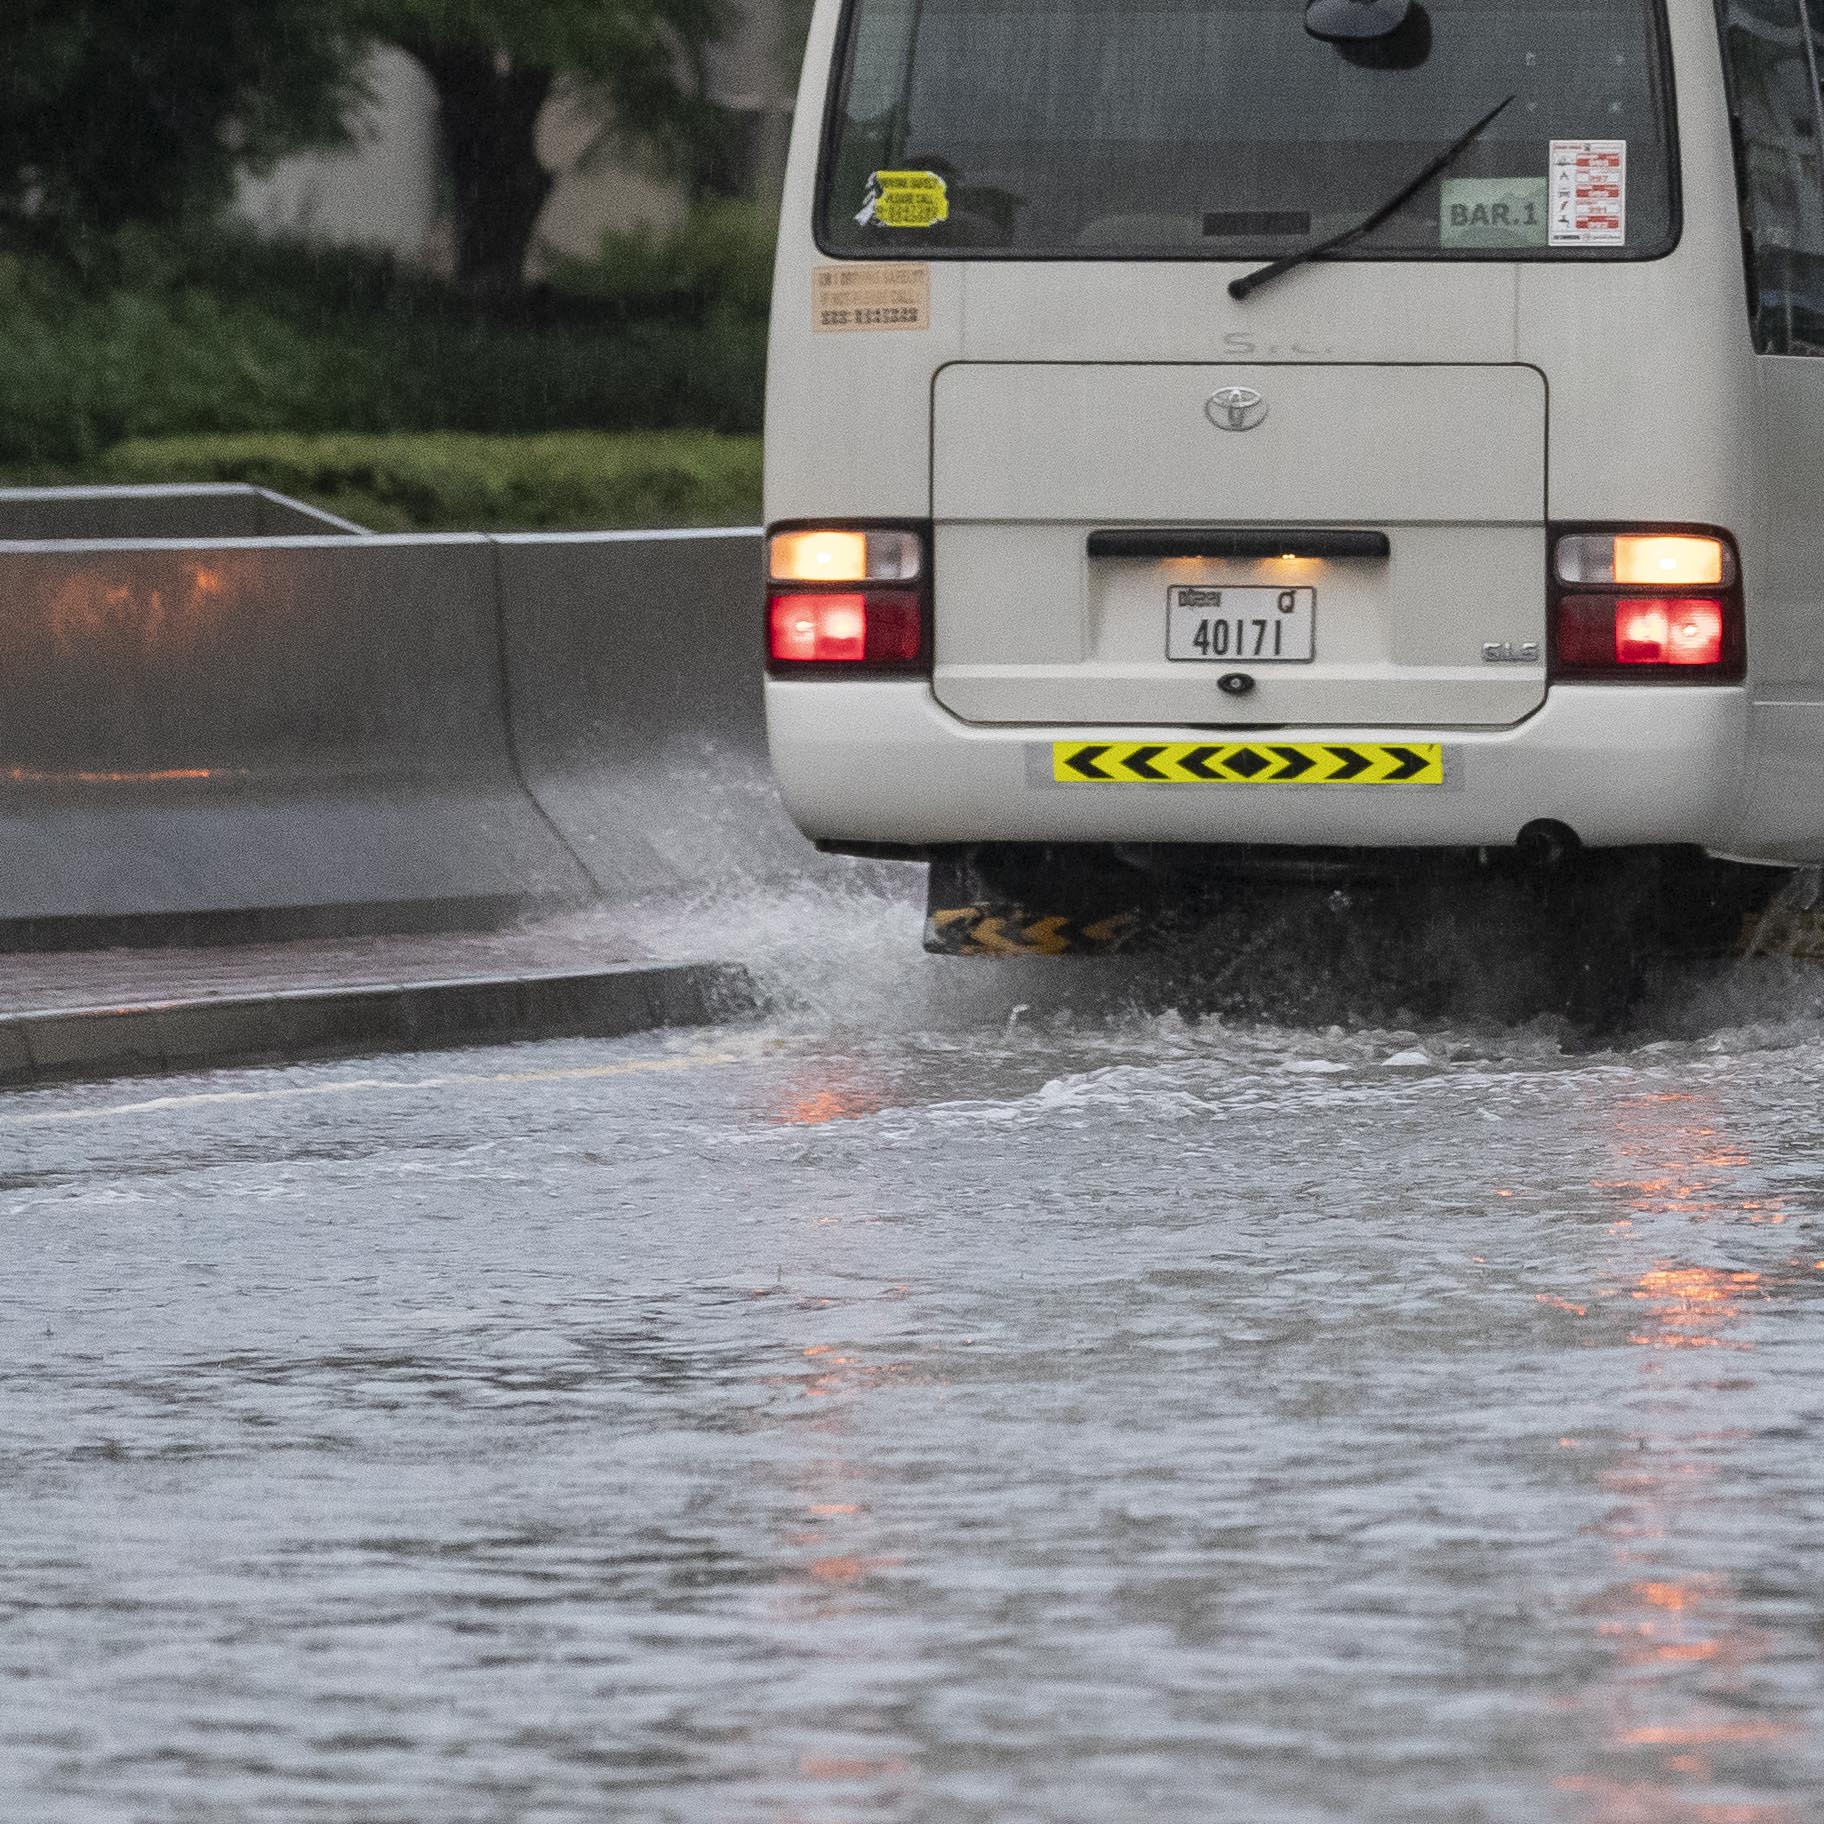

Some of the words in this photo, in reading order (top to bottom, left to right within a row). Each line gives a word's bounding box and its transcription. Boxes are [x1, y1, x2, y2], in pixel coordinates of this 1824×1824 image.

[1450, 202, 1538, 226] BAR.1
[1277, 589, 1297, 614] Q
[1192, 618, 1282, 656] 40171
